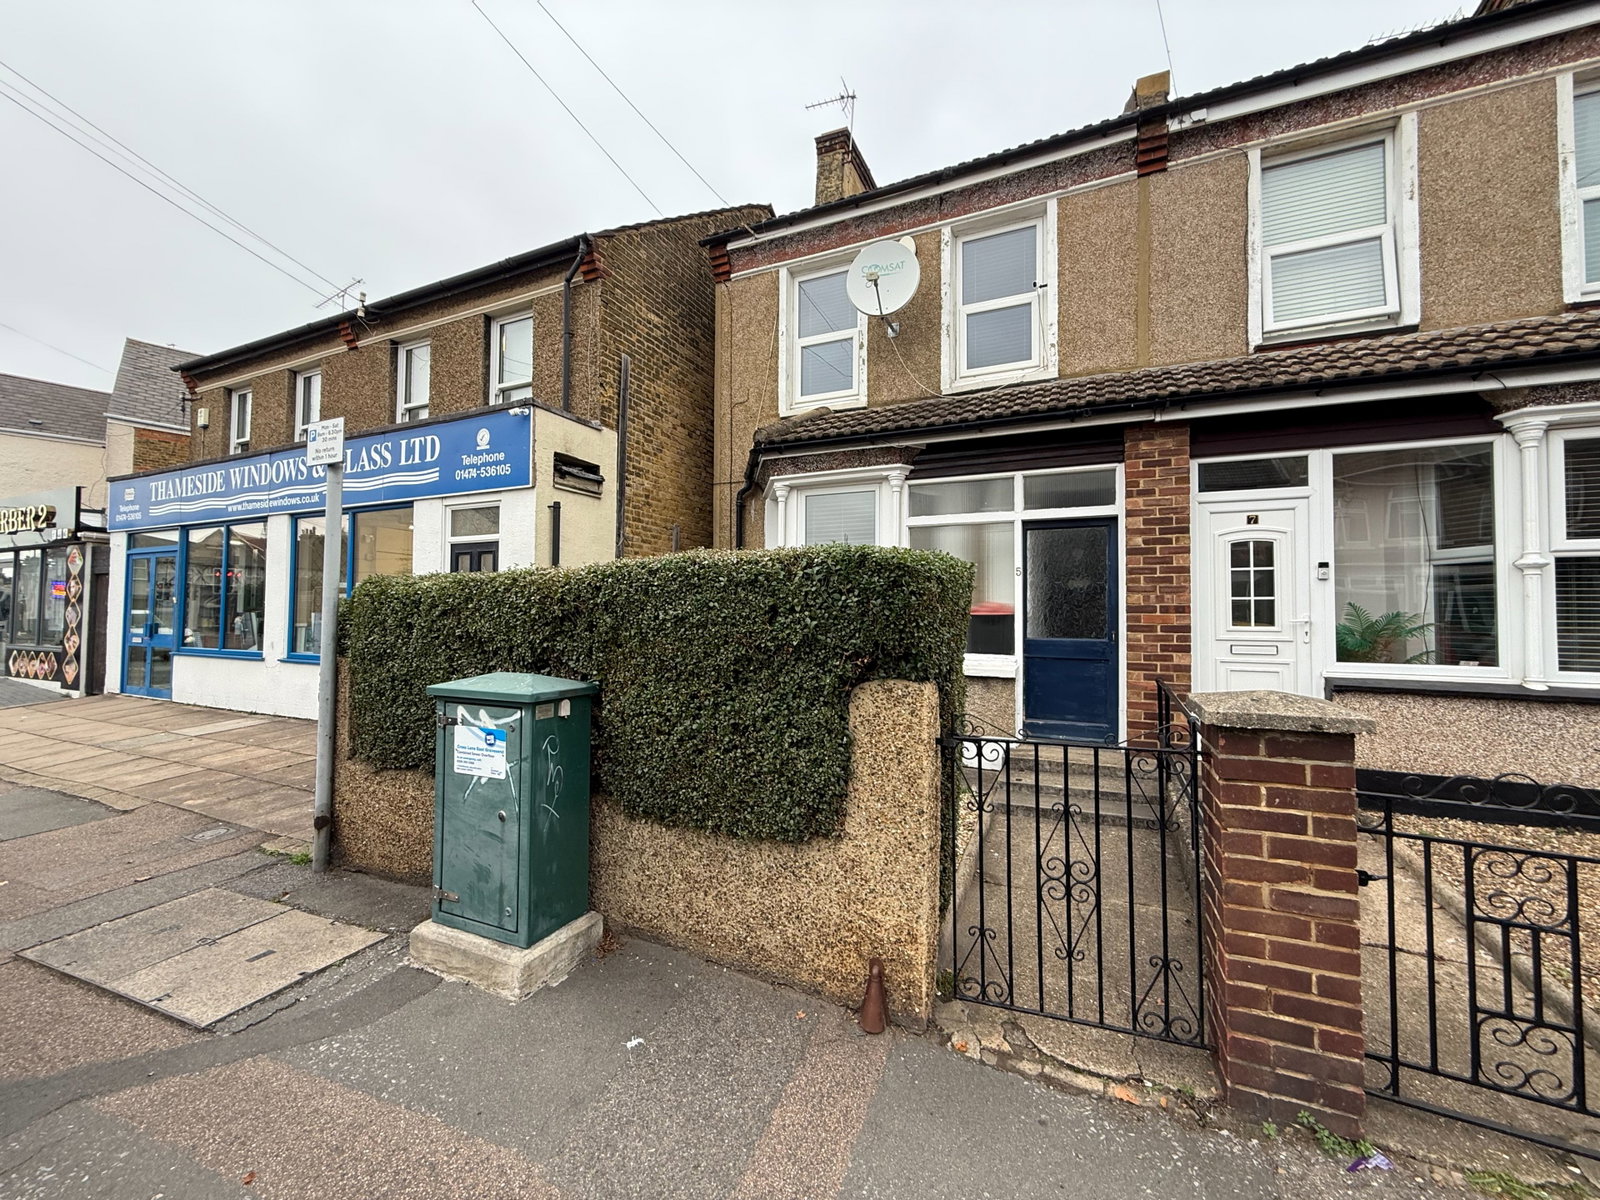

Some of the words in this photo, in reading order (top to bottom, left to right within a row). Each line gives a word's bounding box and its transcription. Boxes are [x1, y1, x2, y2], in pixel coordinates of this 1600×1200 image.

[461, 451, 505, 466] Telephone
[150, 469, 225, 502] THAMESIDE
[229, 457, 307, 490] WINDOWS
[312, 464, 326, 478] &
[343, 442, 392, 474] LASS
[399, 435, 441, 466] LTD
[455, 463, 511, 480] 01474-536105
[119, 504, 139, 513] Telephone
[227, 494, 320, 512] www.thamesidewindows.co.uk
[38, 504, 47, 528] 2
[1248, 515, 1257, 524] 7
[1015, 567, 1022, 577] 5
